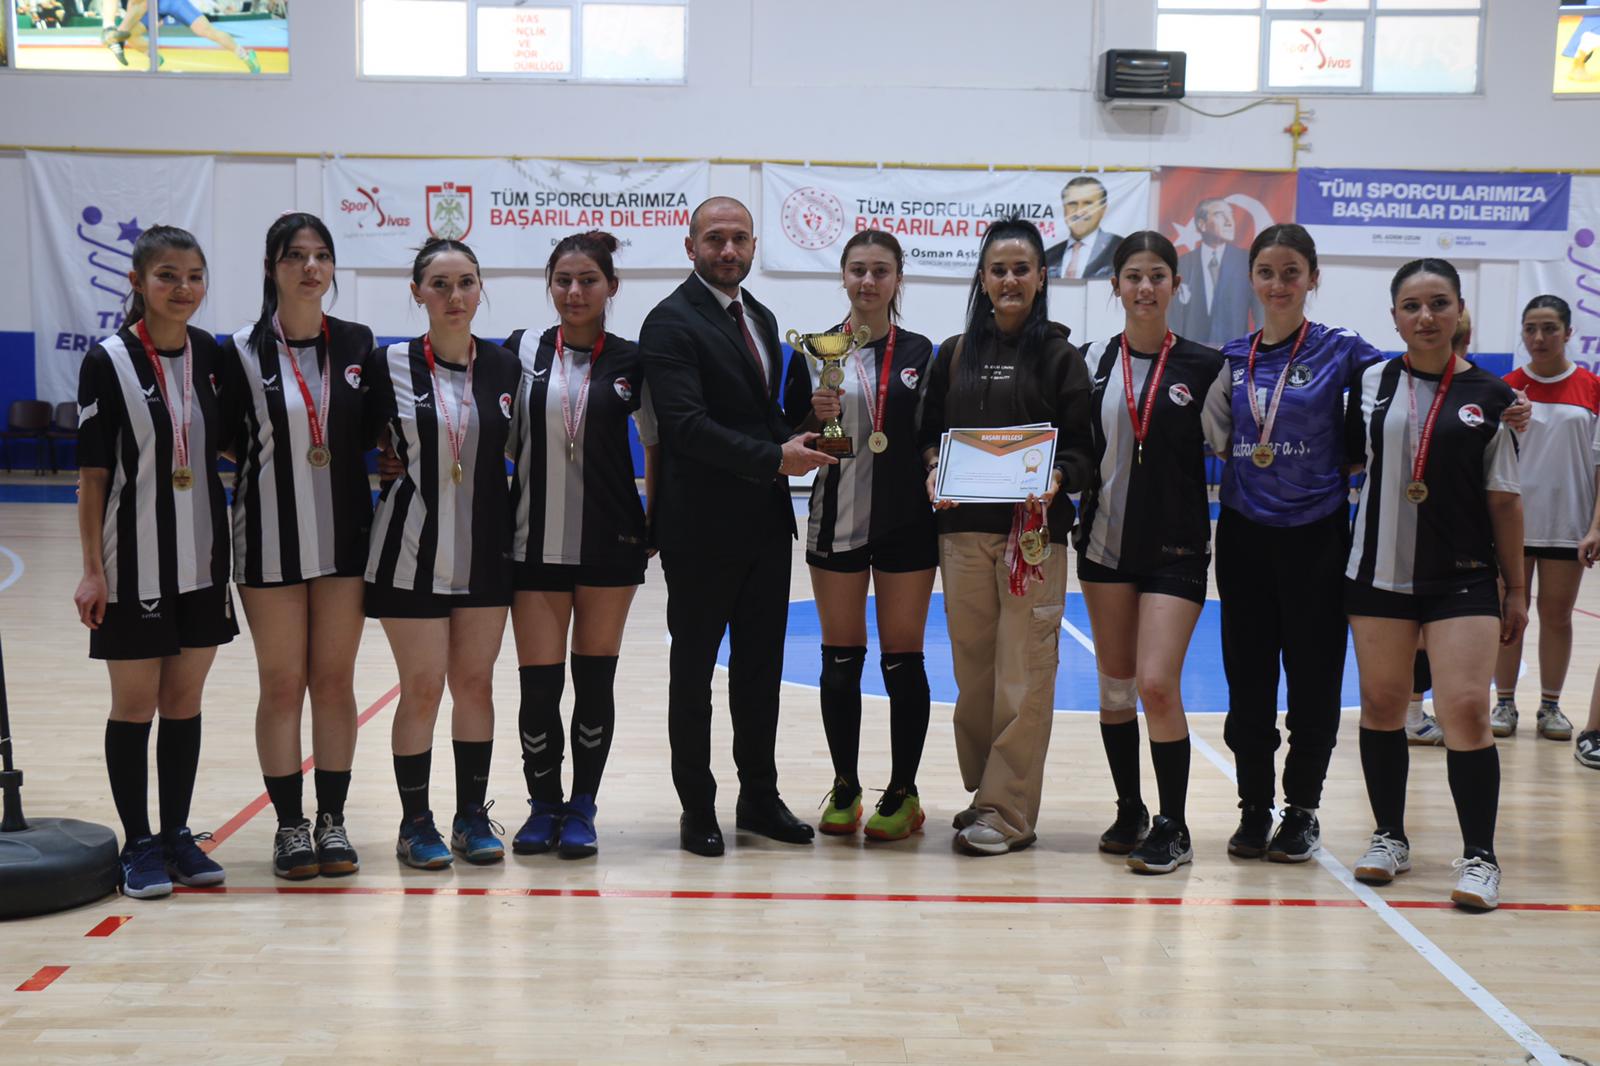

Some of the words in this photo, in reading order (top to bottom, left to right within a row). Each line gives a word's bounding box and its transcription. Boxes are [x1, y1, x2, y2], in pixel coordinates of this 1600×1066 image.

[491, 188, 528, 206] TÜM
[535, 191, 688, 208] SPORCULARIMIZA
[1318, 179, 1363, 198] TÜM
[1367, 183, 1547, 202] SPORCULARIMIZA
[340, 199, 368, 213] Spor
[856, 197, 894, 215] TÜM
[901, 201, 1055, 219] SPORCULARIMIZA
[1332, 201, 1445, 222] BAŞARILAR
[490, 208, 604, 230] BAŞARILAR
[911, 247, 953, 258] Osman
[956, 249, 979, 261] Aşk
[55, 332, 109, 352] ERK
